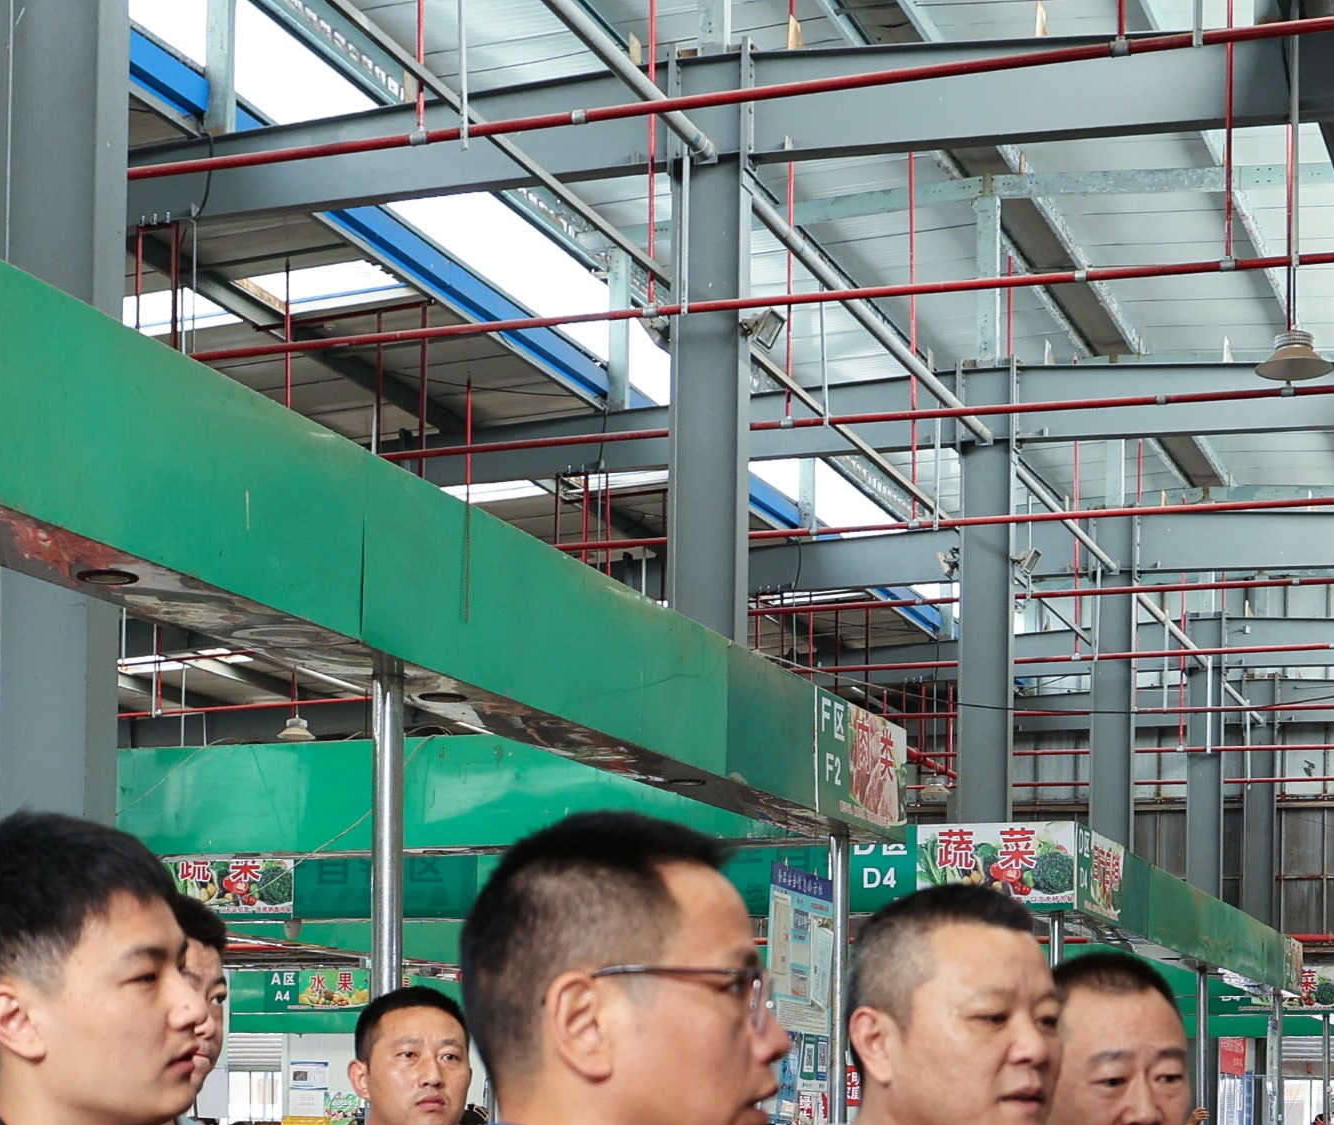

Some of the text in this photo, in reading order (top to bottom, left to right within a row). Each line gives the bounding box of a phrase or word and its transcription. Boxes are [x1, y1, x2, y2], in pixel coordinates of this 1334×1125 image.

[821, 696, 845, 742] F区
[857, 719, 895, 783] 肉类
[825, 752, 842, 786] F2
[938, 828, 1036, 869] 蔬菜
[863, 868, 897, 888] D4
[271, 972, 354, 993] A区 水果
[274, 991, 291, 1002] A4
